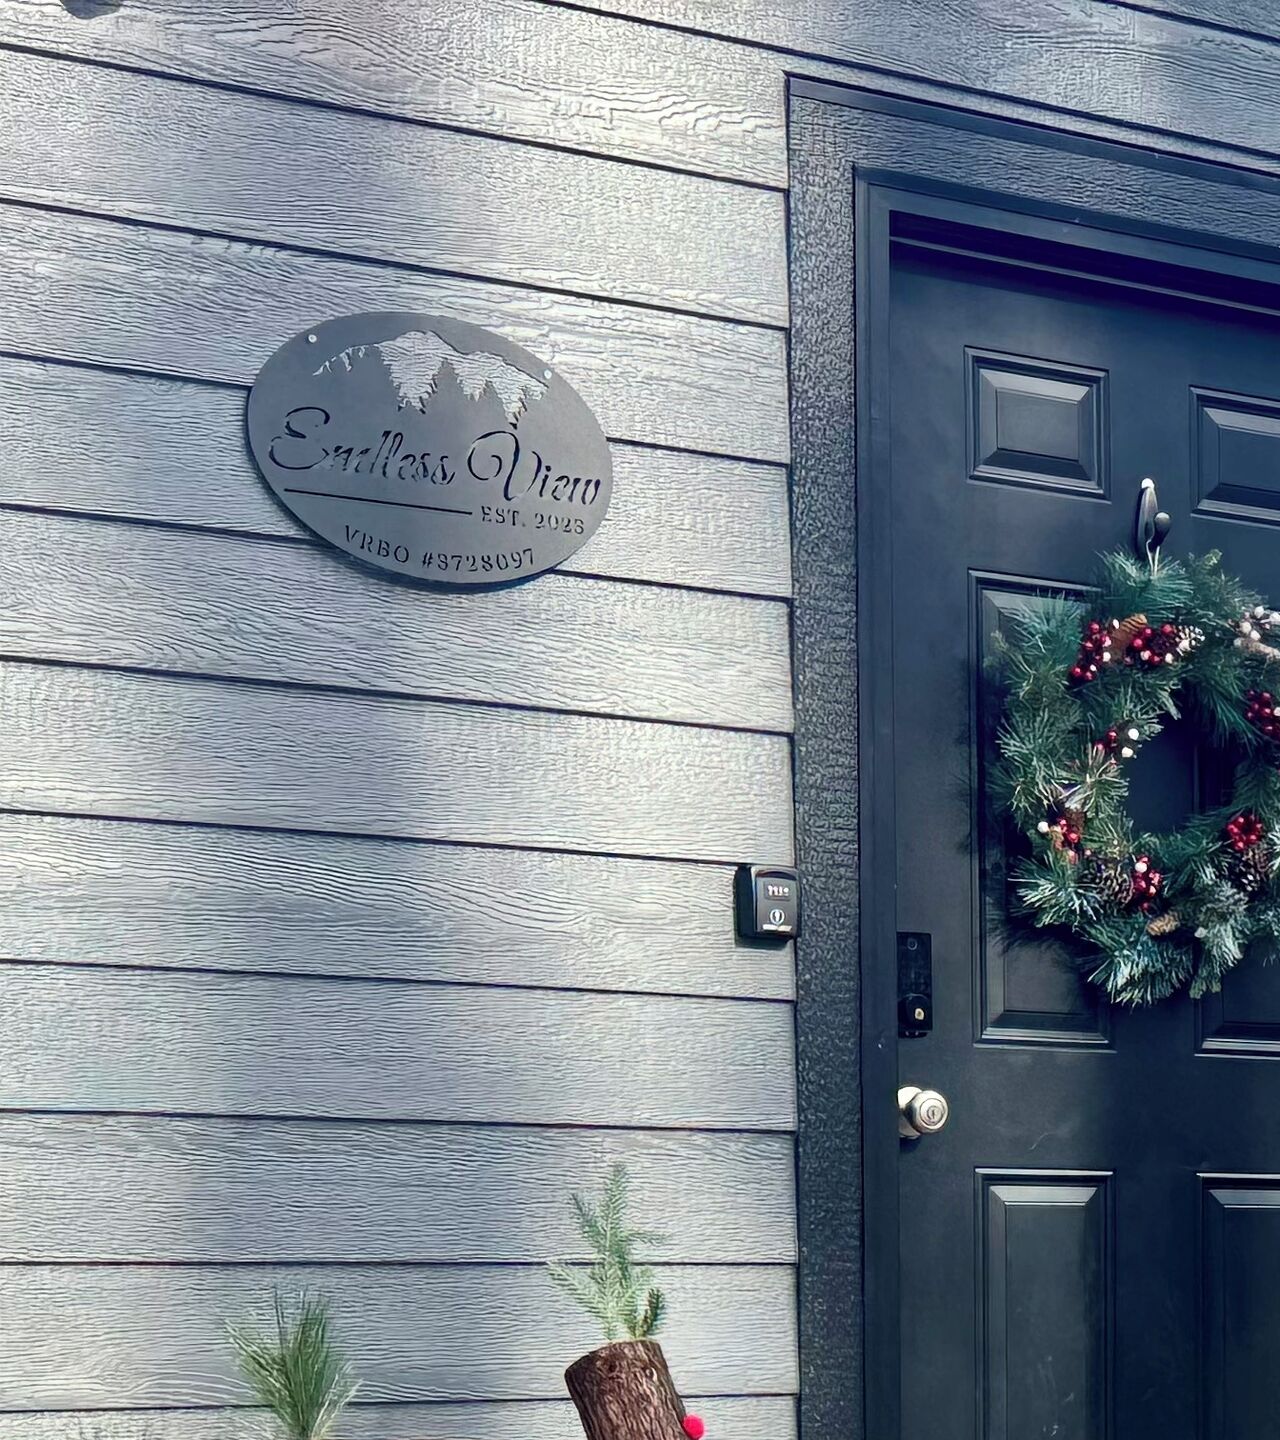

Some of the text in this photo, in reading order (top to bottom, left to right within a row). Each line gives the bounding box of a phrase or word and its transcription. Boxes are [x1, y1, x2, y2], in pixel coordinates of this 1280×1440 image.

[268, 406, 601, 505] Endless View
[481, 505, 526, 527] EST.
[345, 524, 410, 564] VRBO
